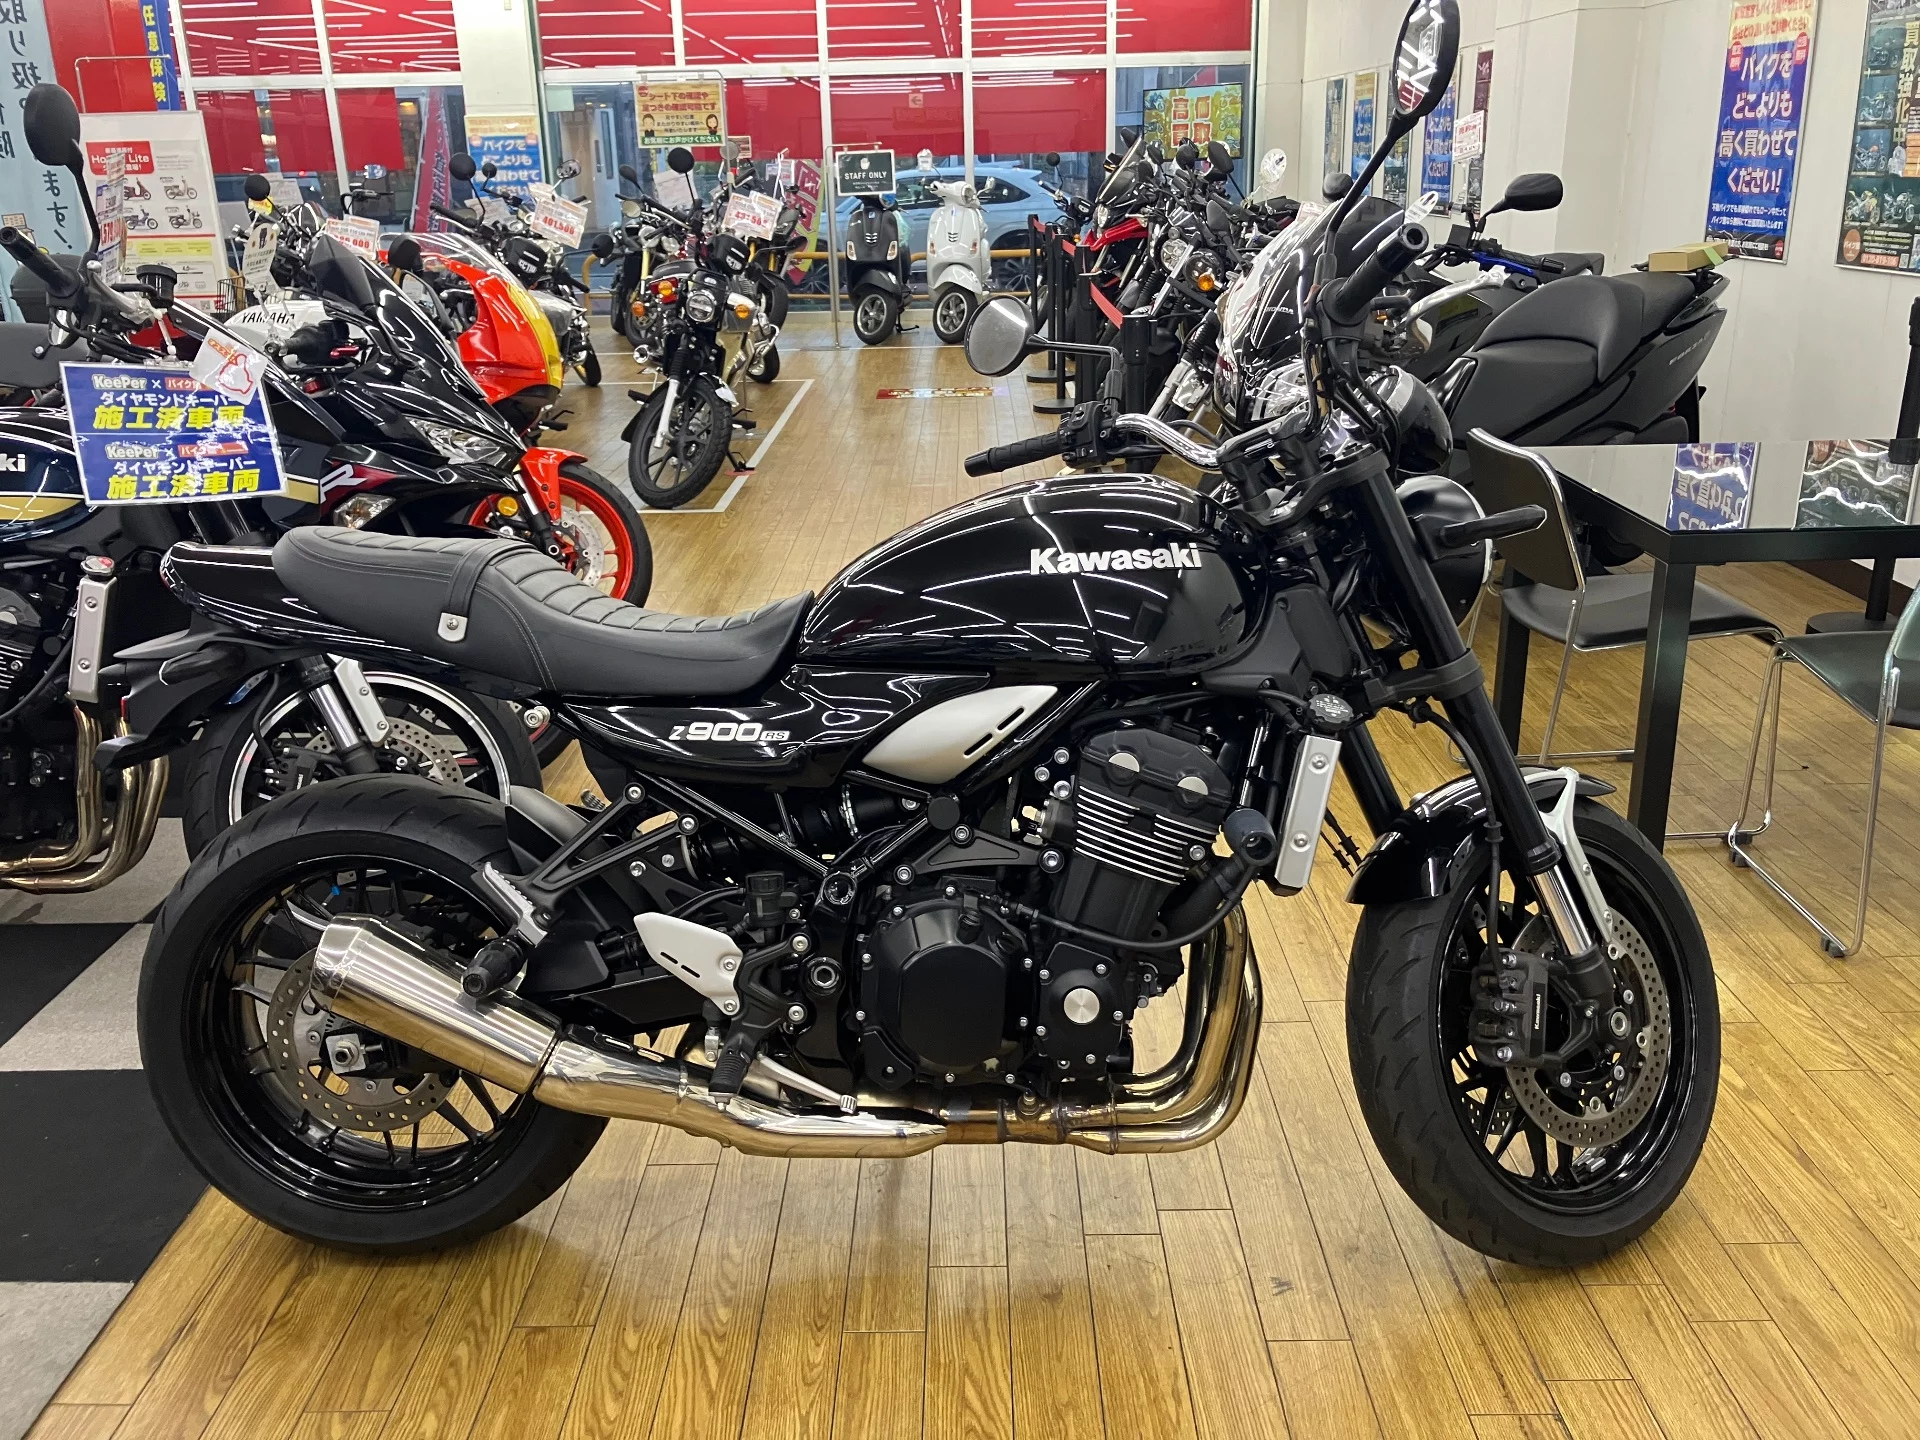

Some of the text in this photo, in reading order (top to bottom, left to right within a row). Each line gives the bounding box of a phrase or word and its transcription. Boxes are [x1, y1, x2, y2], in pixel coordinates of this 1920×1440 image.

[1740, 51, 1793, 81] バイクを
[1731, 90, 1793, 120] どこよりも
[483, 139, 527, 151] バイクを
[1719, 128, 1797, 159] 高く買わせて
[844, 171, 887, 180] STAFF ONLY
[242, 311, 295, 325] YAMAHA
[92, 374, 147, 390] KeePer
[92, 405, 246, 430] 施工済車両
[106, 444, 159, 459] KeePer
[106, 468, 261, 500] 施工済車両
[1030, 542, 1202, 575] Kawasaki
